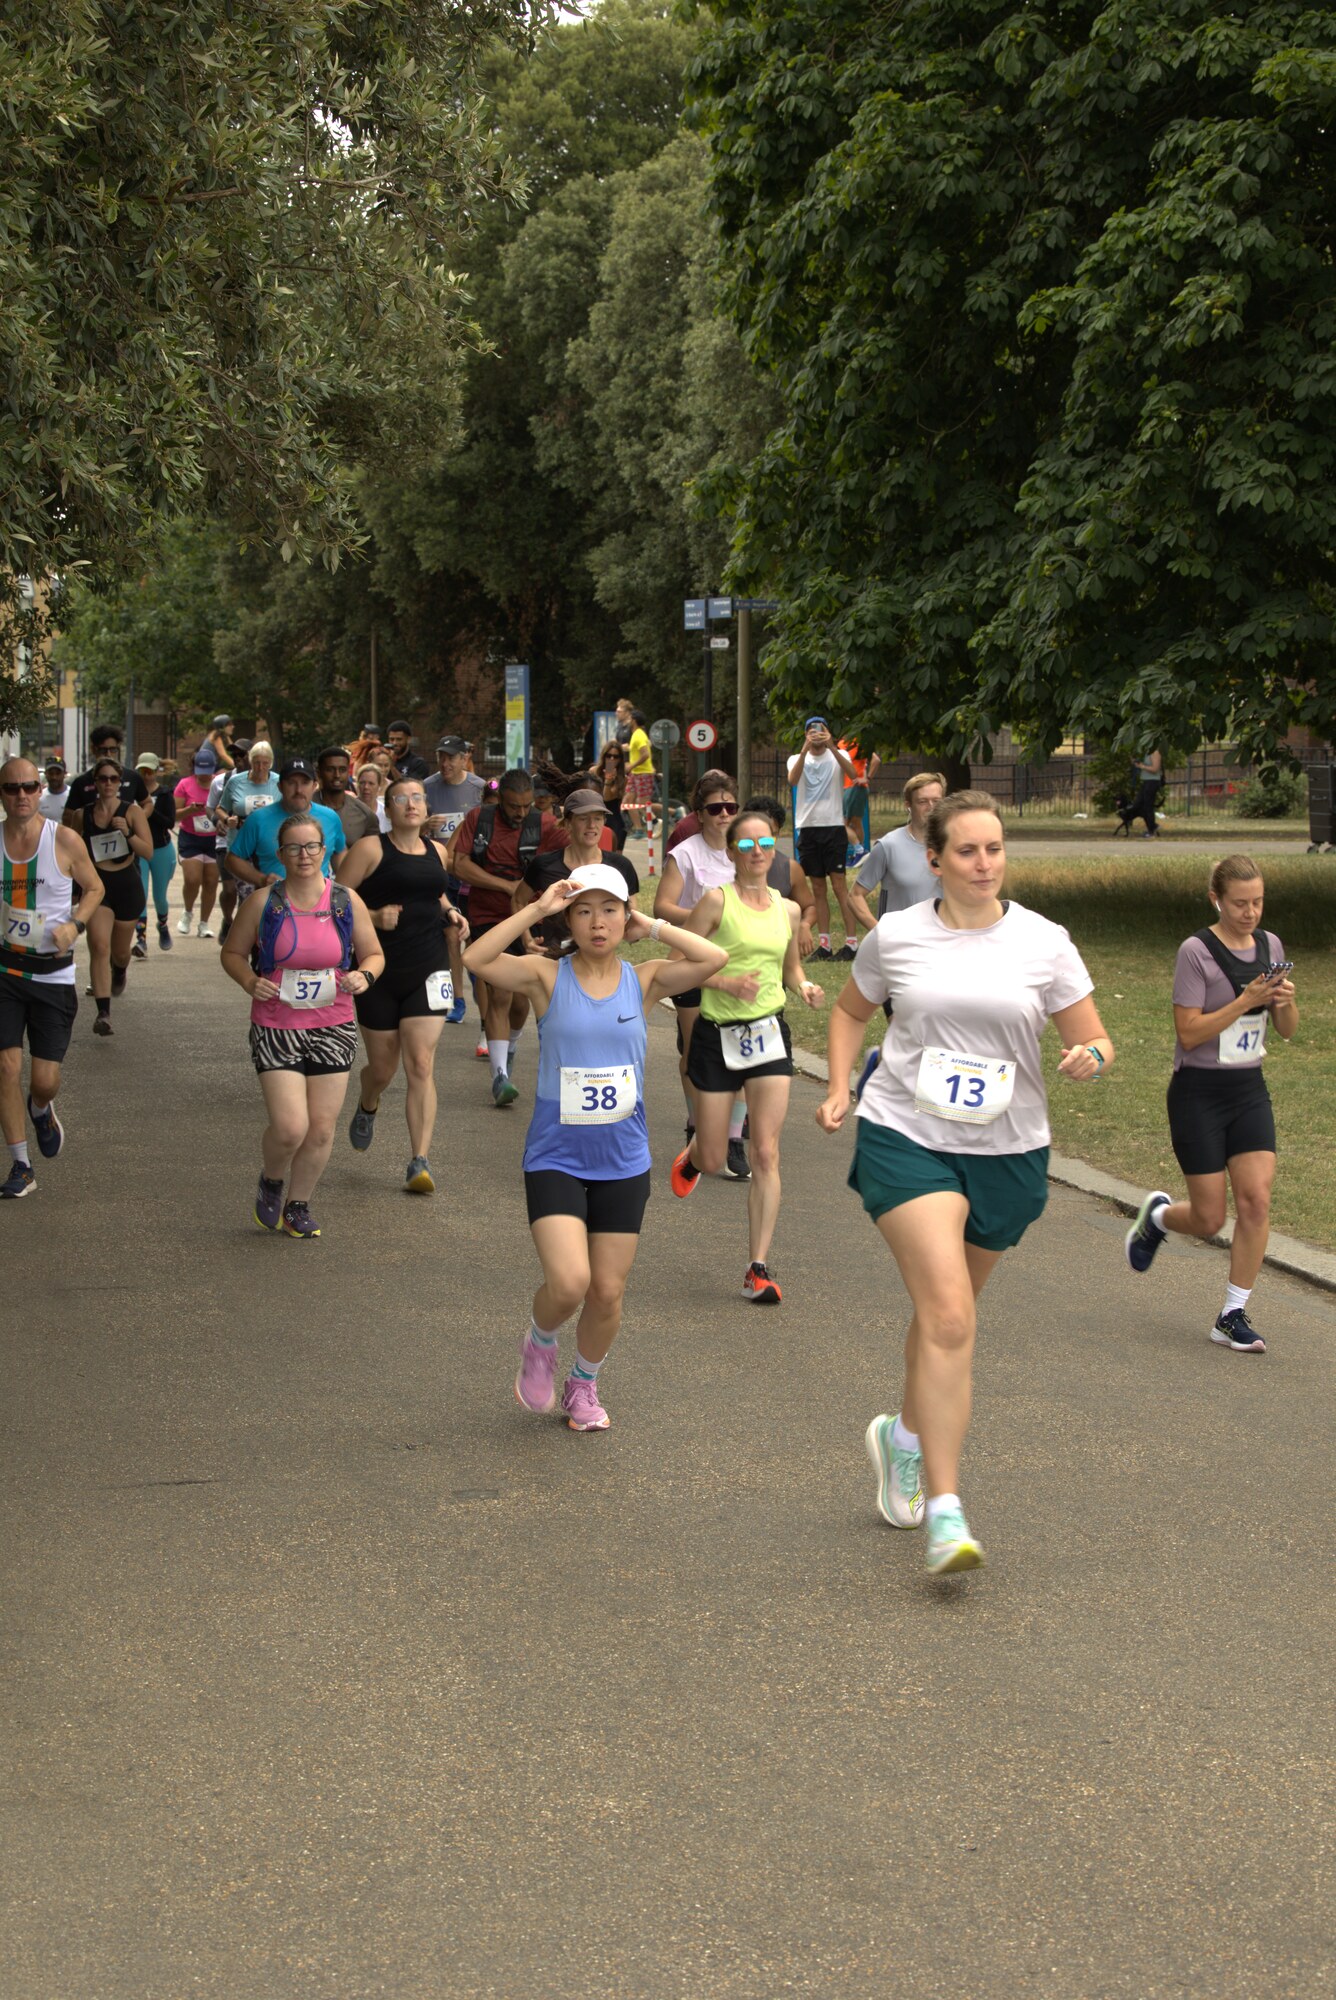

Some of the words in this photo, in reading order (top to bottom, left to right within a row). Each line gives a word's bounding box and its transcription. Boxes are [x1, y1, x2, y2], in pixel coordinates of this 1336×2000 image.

[697, 729, 706, 742] 5
[440, 821, 456, 832] 26
[101, 840, 117, 854] 77
[8, 918, 31, 937] 79
[295, 981, 322, 1000] 37
[740, 1034, 764, 1056] 81
[1236, 1030, 1260, 1051] 47
[950, 1058, 988, 1069] AFFORDABLE
[581, 1085, 617, 1111] 38
[945, 1074, 986, 1108] 13
